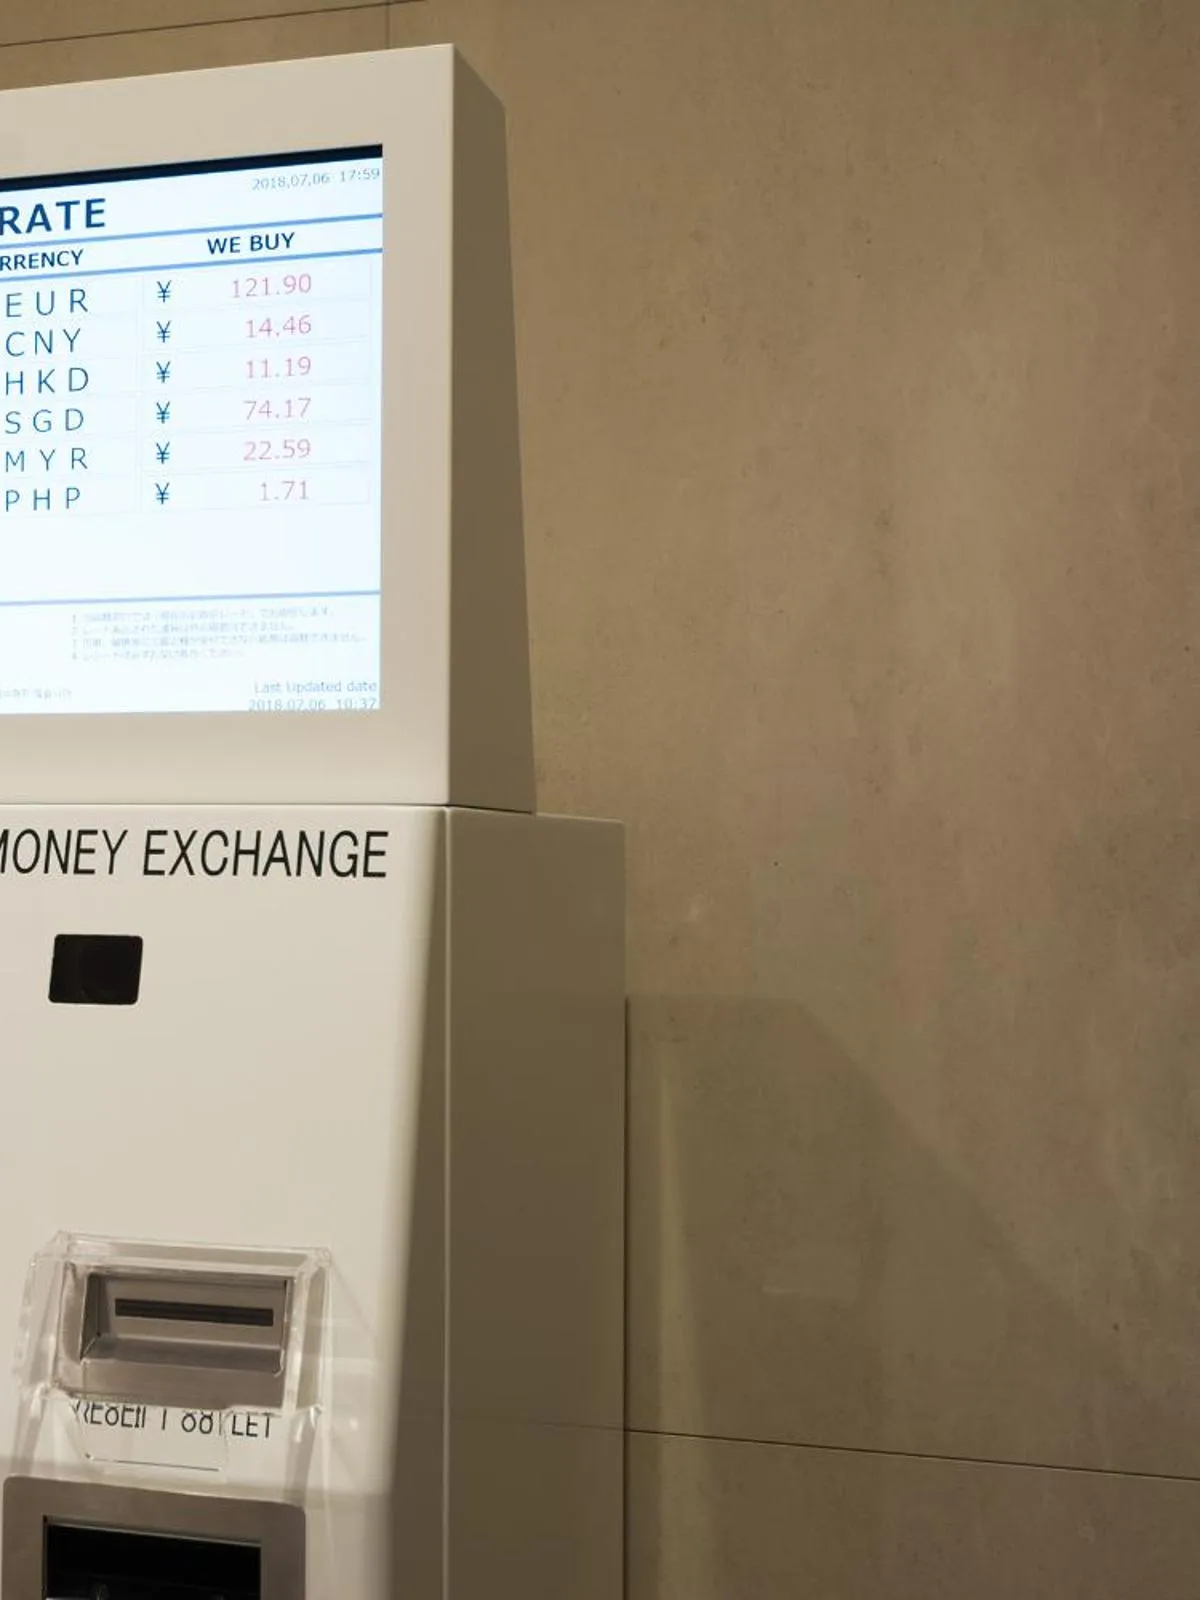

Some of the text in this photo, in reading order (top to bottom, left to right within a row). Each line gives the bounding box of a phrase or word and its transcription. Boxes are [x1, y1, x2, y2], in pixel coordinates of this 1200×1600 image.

[340, 167, 380, 183] 17:59
[207, 235, 241, 255] WE
[249, 232, 295, 251] BUY
[6, 287, 89, 318] EUR
[231, 273, 312, 299] 121.90
[5, 328, 82, 358] CNY
[246, 314, 312, 339] 14.46
[5, 366, 89, 396] HKD
[246, 356, 312, 379] 11.19
[5, 408, 84, 435] SGD
[244, 397, 312, 420] 74.17
[5, 447, 89, 474] MYR
[243, 439, 311, 462] 22.59
[5, 487, 81, 512] PHP
[259, 480, 309, 501] 1.71
[254, 680, 377, 695] Last Updated date
[143, 829, 389, 878] EXCHANGE
